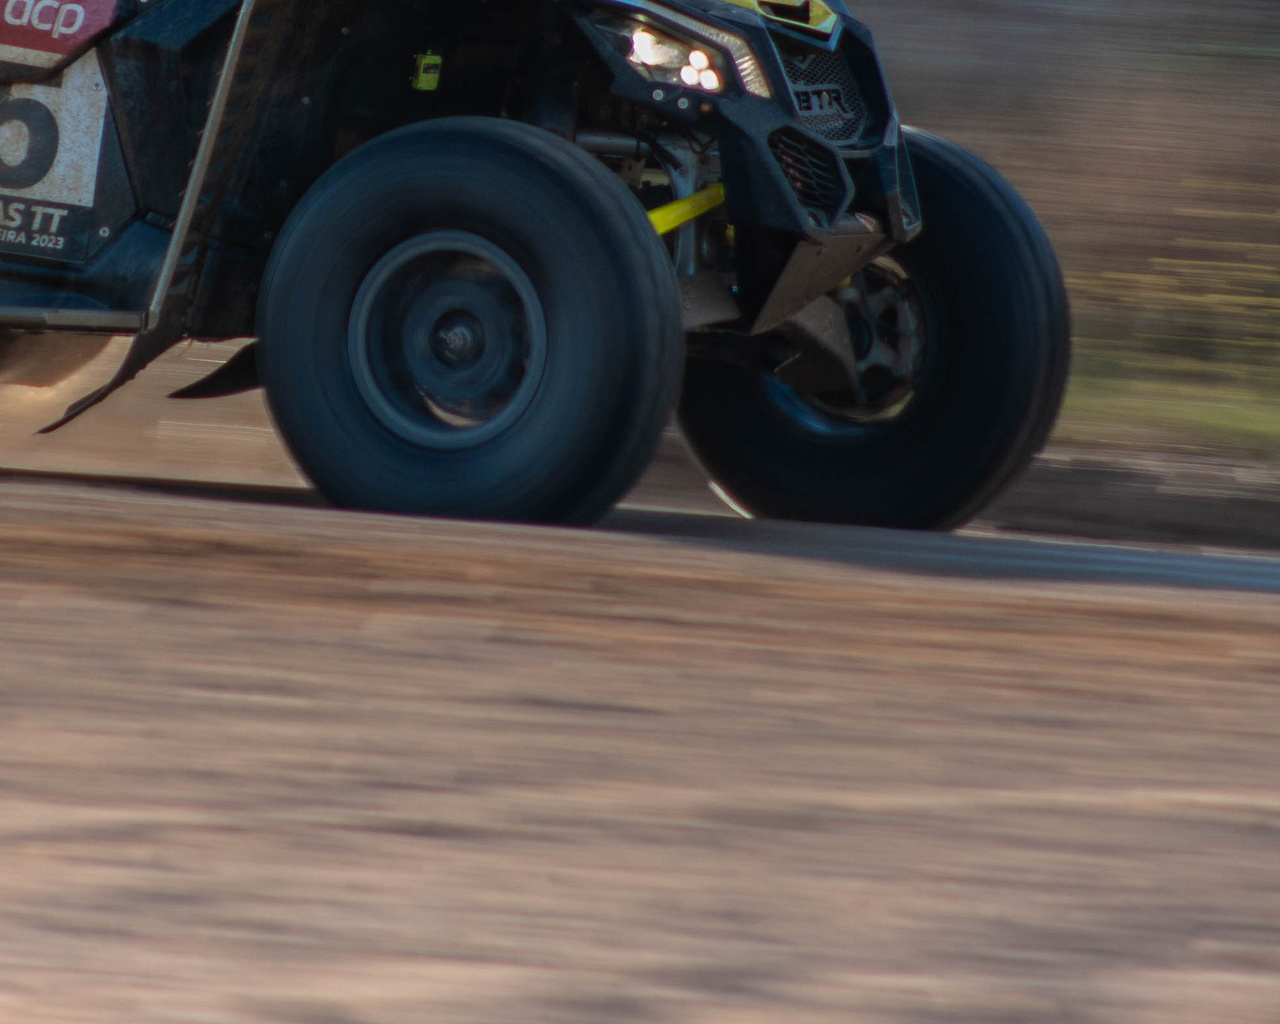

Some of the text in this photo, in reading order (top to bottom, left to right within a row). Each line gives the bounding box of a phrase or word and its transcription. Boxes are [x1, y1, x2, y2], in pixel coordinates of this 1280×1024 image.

[795, 89, 848, 112] BTR
[30, 206, 69, 234] TT
[30, 233, 65, 250] 2023
